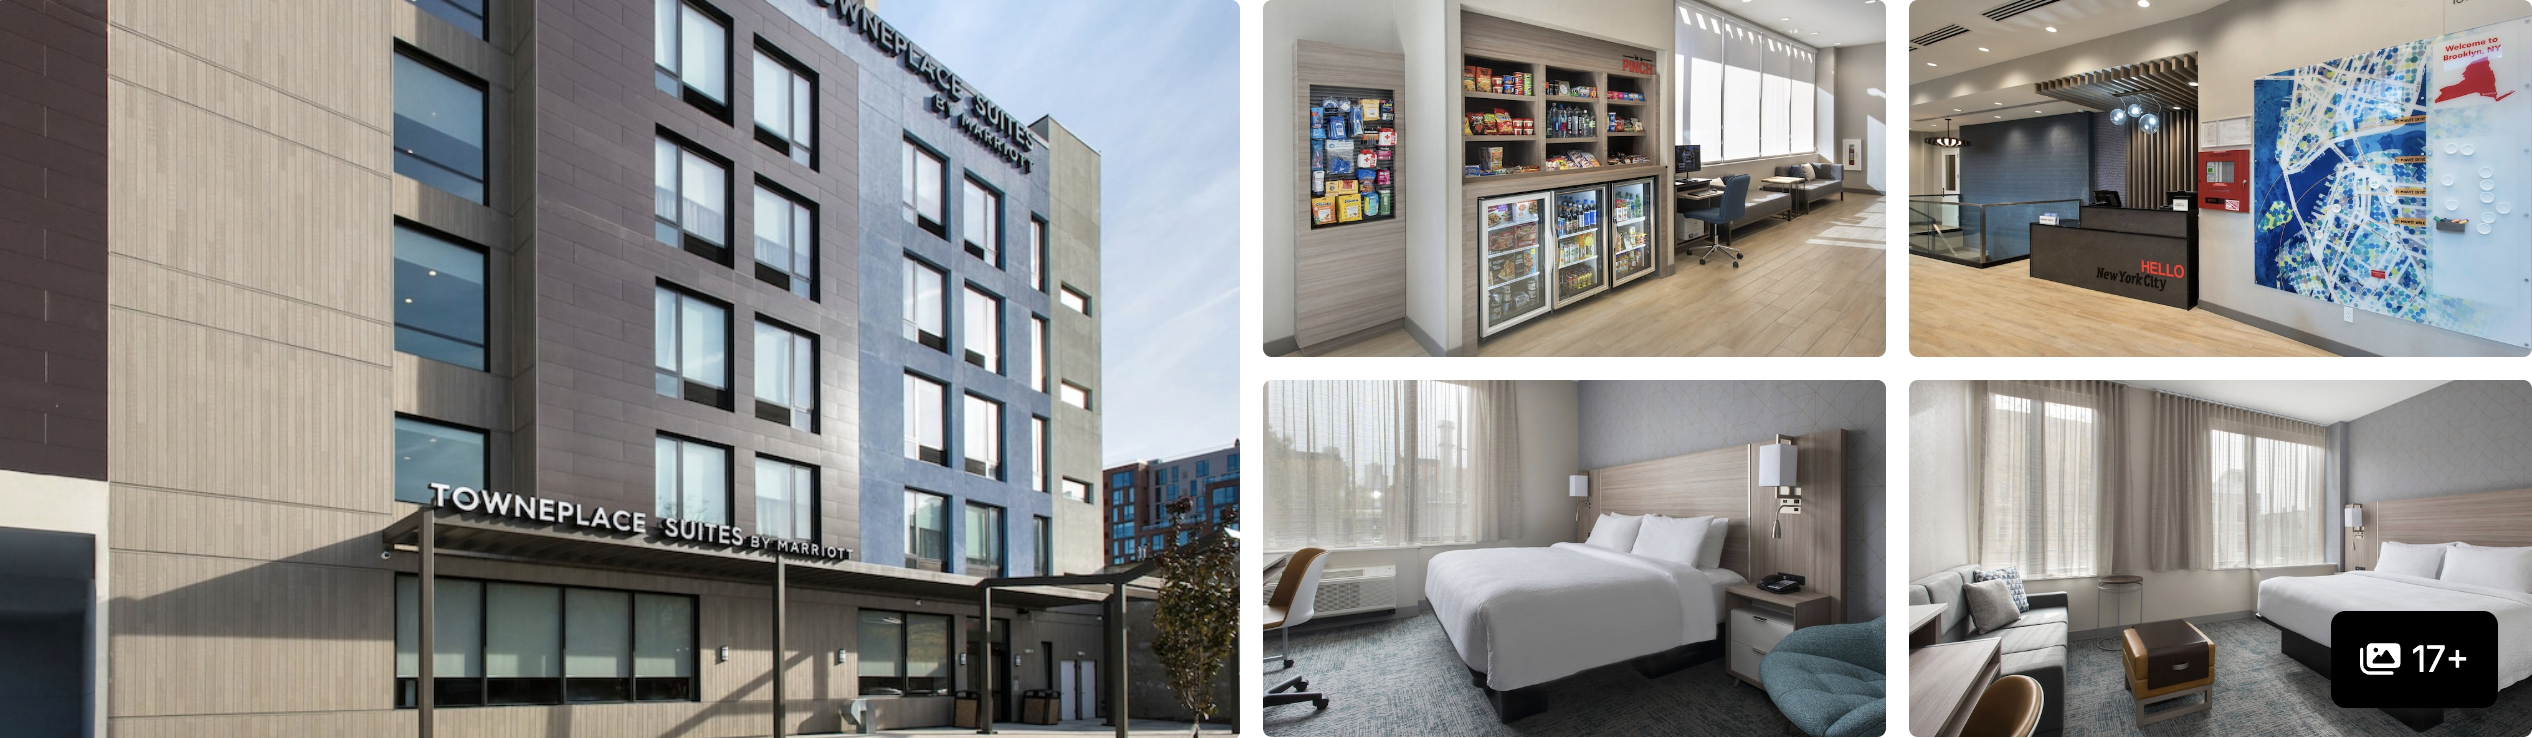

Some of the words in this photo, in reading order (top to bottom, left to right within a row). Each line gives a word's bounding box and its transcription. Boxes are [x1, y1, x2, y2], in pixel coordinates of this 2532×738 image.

[2443, 49, 2485, 61] Brooklyn,
[2487, 44, 2502, 53] NY
[2445, 39, 2486, 52] Welcome
[816, 0, 963, 101] WNEPLACE
[972, 92, 1035, 153] SUITES
[1622, 58, 1653, 76] PINCH
[932, 94, 957, 117] BY
[959, 112, 1034, 174] MARRIOTT
[2096, 267, 2118, 281] New
[2118, 272, 2142, 286] York
[2143, 273, 2166, 292] City
[2141, 259, 2185, 279] HELLO
[429, 482, 647, 534] TOWNEPLACE
[664, 517, 744, 546] SUITES
[750, 535, 771, 549] BY
[777, 539, 854, 560] MARRIOTT
